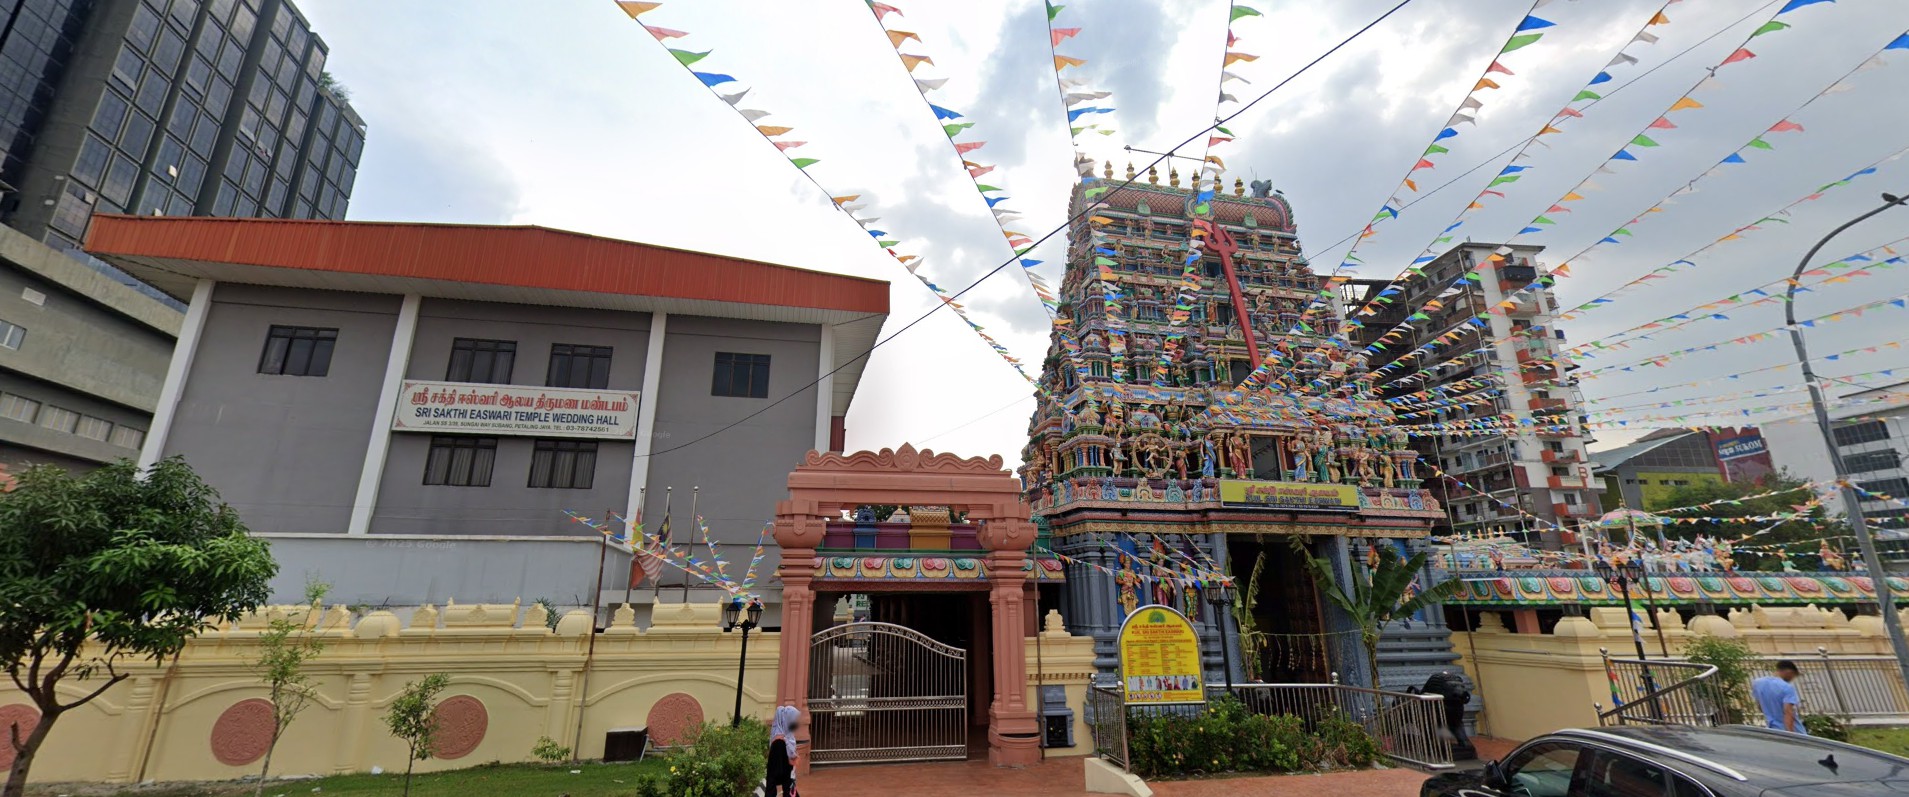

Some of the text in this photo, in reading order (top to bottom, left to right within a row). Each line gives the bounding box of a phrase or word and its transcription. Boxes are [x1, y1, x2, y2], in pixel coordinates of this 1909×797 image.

[430, 388, 456, 406] சக்தி
[458, 389, 499, 405] ஈஸ்வரி
[500, 395, 533, 408] ஆலய
[534, 393, 578, 411] திருமண
[580, 395, 628, 412] மண்டபம்
[415, 407, 619, 426] SRI SAKTHI EASWARI TEMPLE WEDDING HALL
